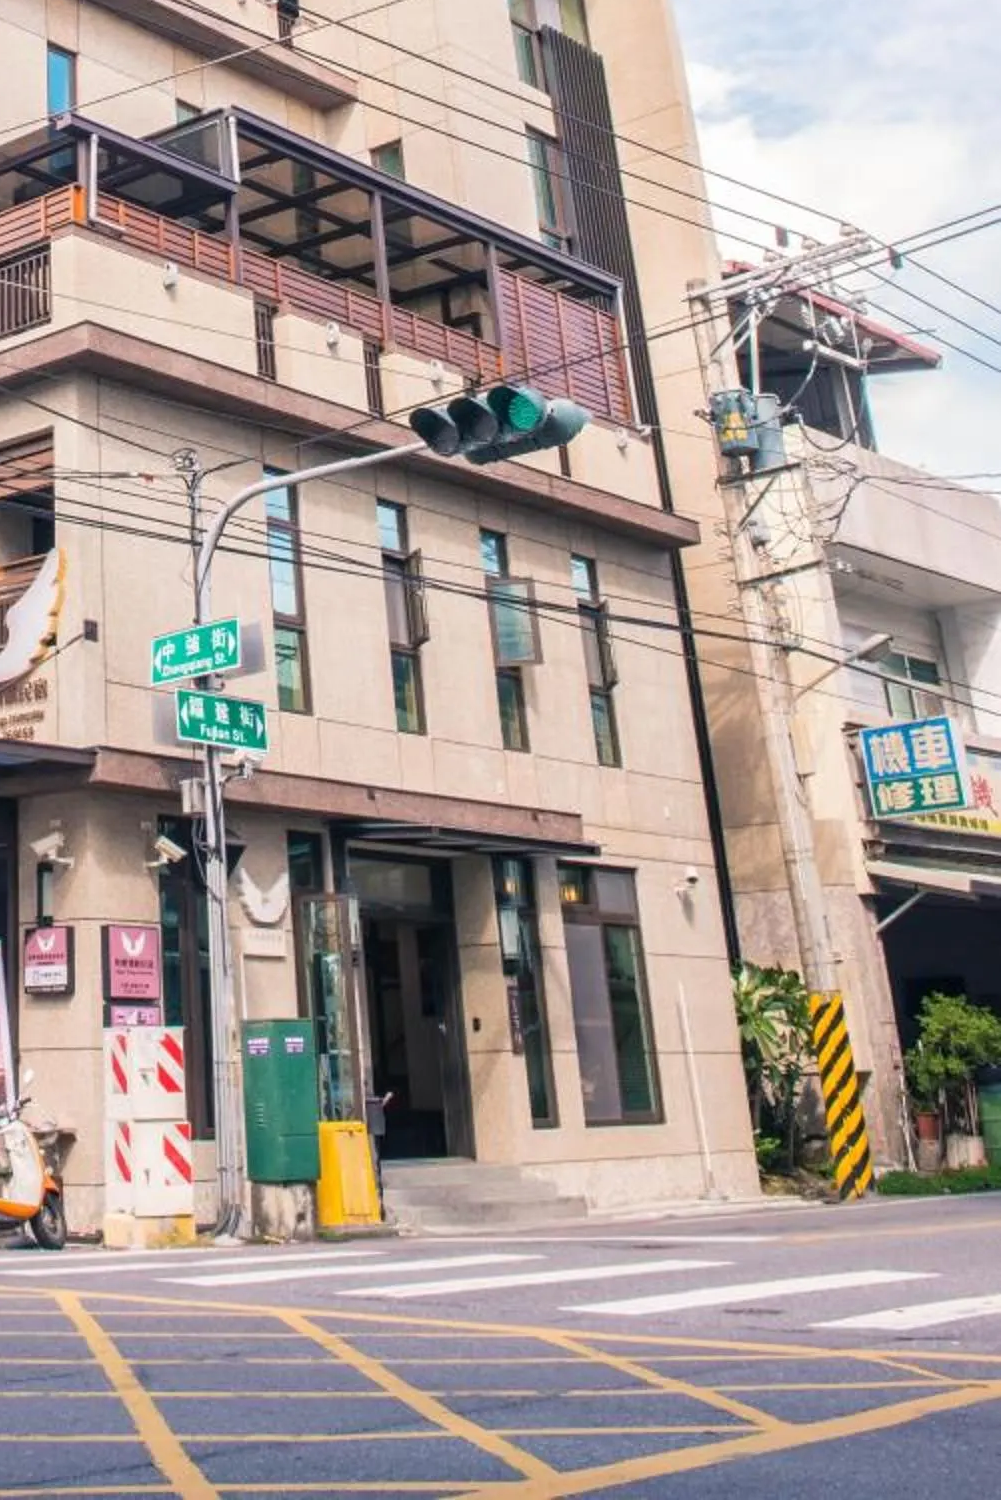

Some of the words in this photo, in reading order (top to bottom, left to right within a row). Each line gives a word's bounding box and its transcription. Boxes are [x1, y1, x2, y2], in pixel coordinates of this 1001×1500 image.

[214, 651, 228, 665] St.
[867, 724, 953, 777] 機車
[877, 773, 960, 812] 修理
